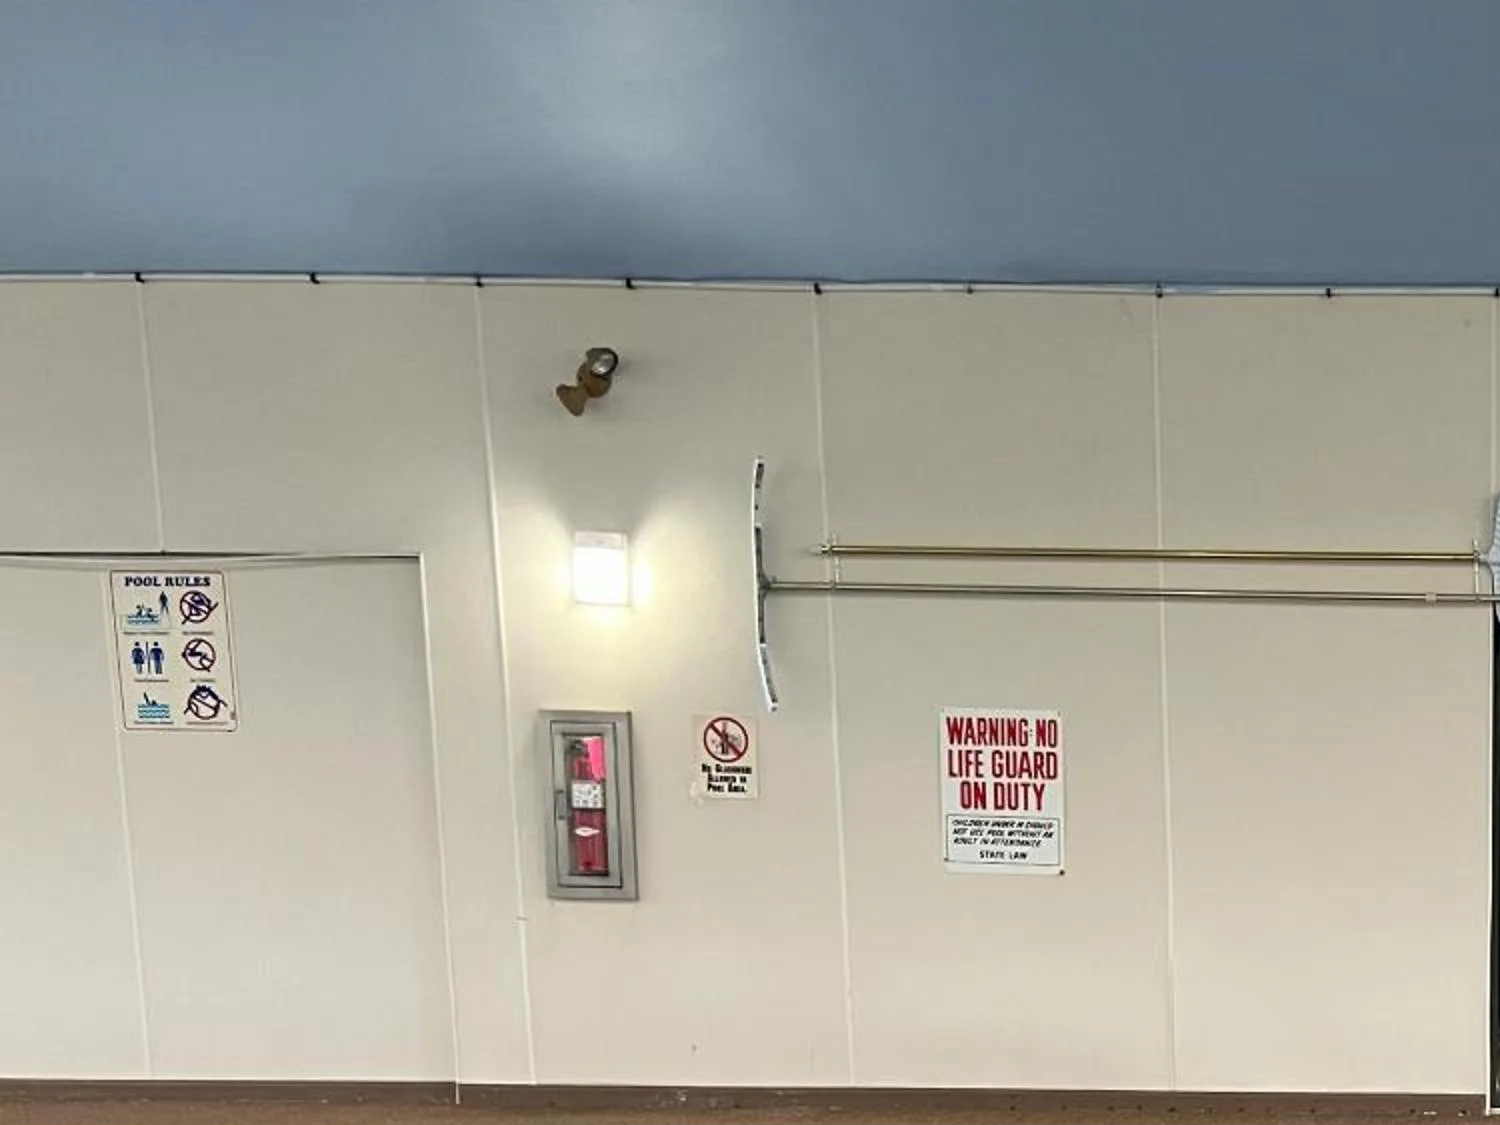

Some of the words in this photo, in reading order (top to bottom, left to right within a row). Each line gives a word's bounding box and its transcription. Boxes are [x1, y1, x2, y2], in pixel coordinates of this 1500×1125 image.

[124, 576, 161, 587] POOL
[165, 576, 211, 587] RULES
[1036, 719, 1058, 748] NO
[948, 750, 984, 778] LIFE
[991, 750, 1058, 780] GUARD
[960, 780, 987, 810] ON
[993, 782, 1046, 811] DUTY
[980, 850, 1005, 859] STATE
